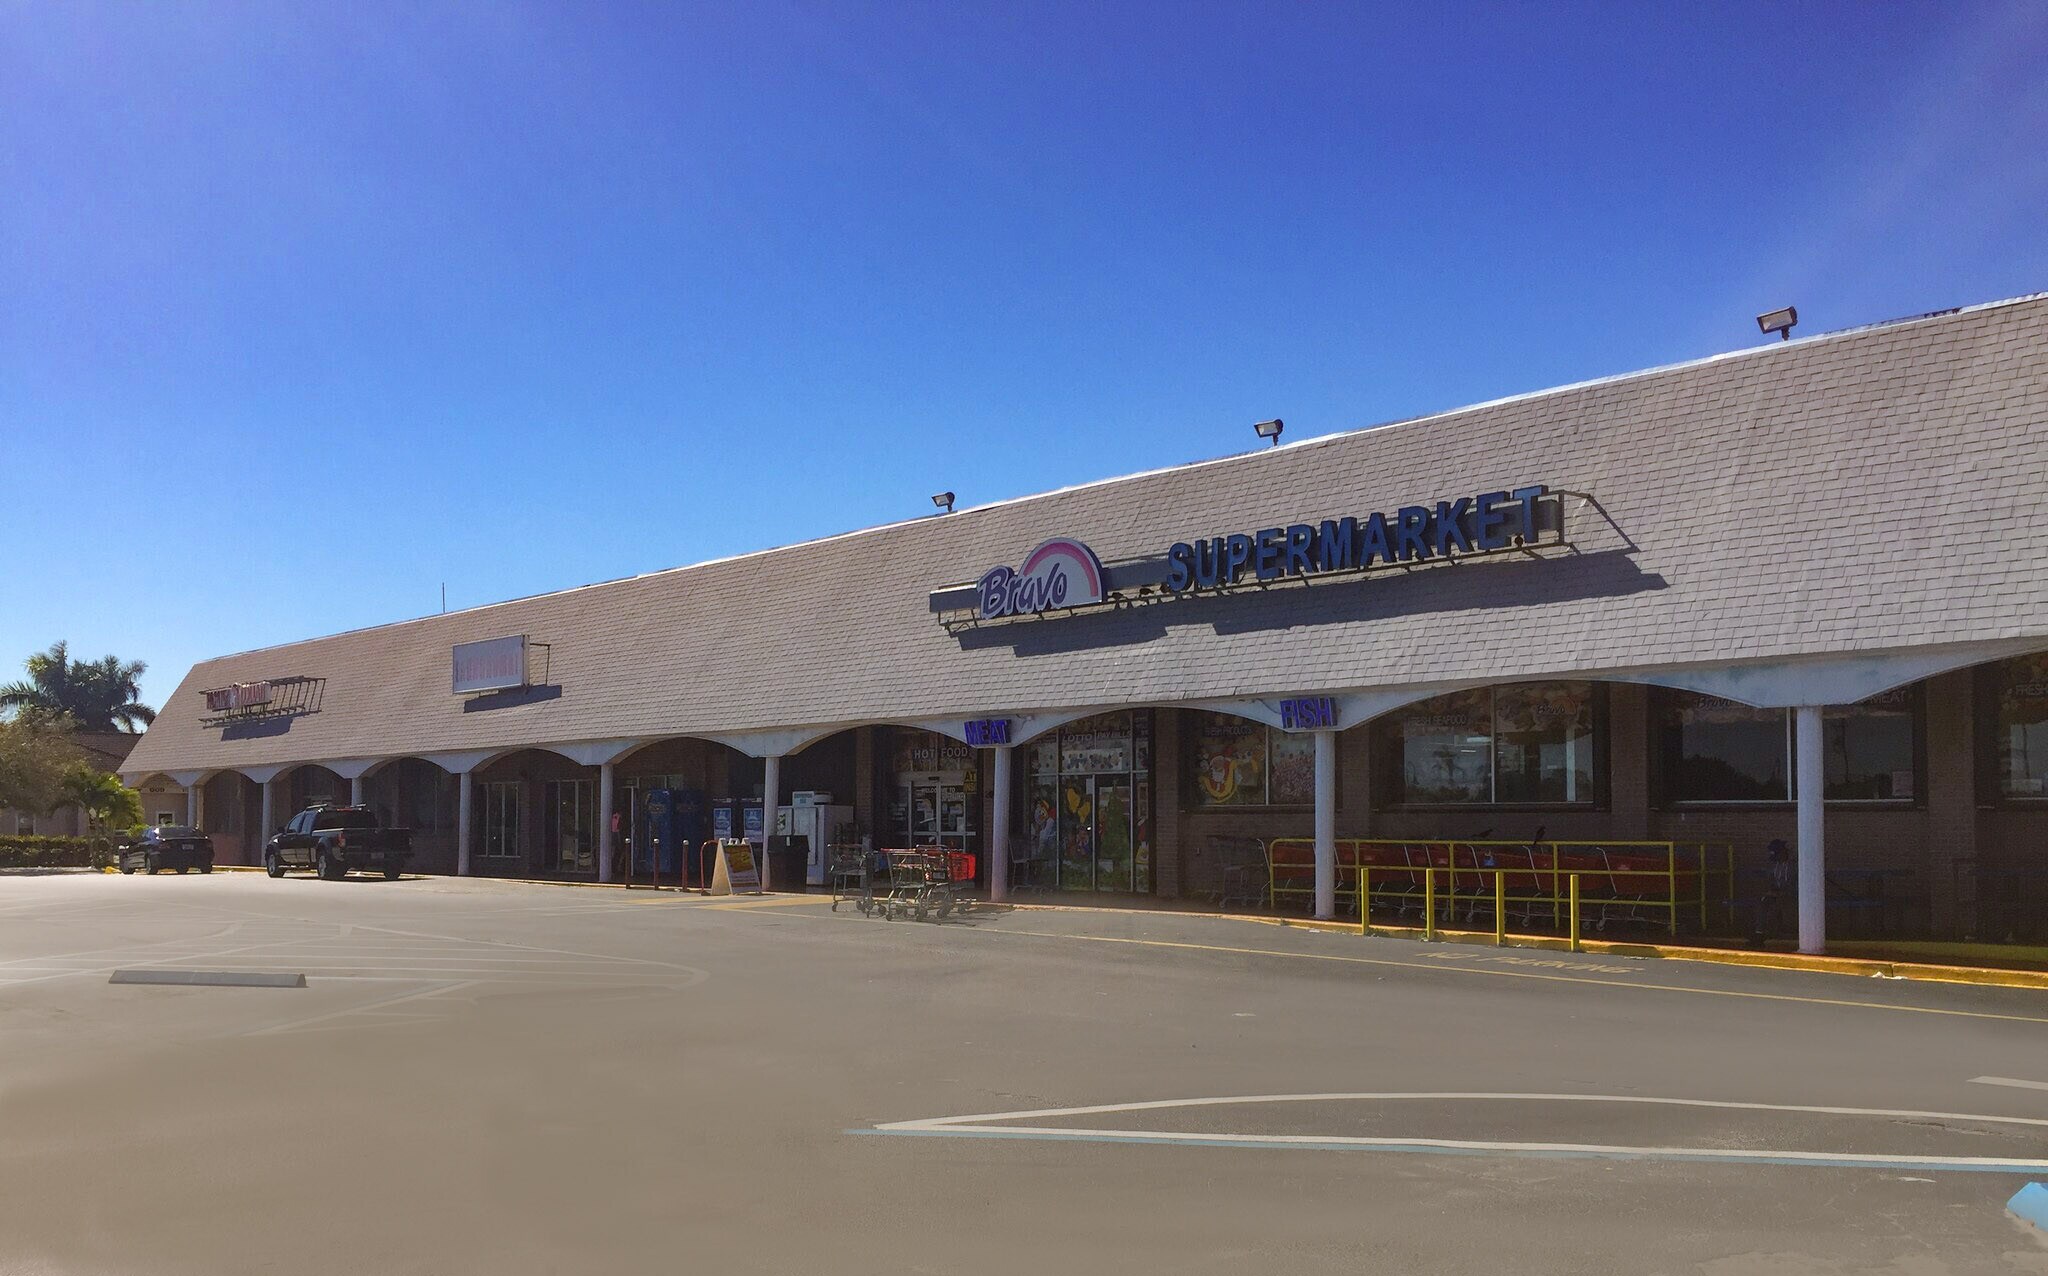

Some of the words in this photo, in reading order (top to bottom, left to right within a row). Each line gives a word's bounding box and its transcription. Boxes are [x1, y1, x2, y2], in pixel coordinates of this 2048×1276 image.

[979, 564, 1067, 618] Bravo
[1167, 485, 1546, 593] SUPERMARKET
[1280, 697, 1332, 729] FISH
[964, 719, 1007, 746] MEAT
[914, 748, 936, 759] HOT
[940, 747, 968, 758] FOOD
